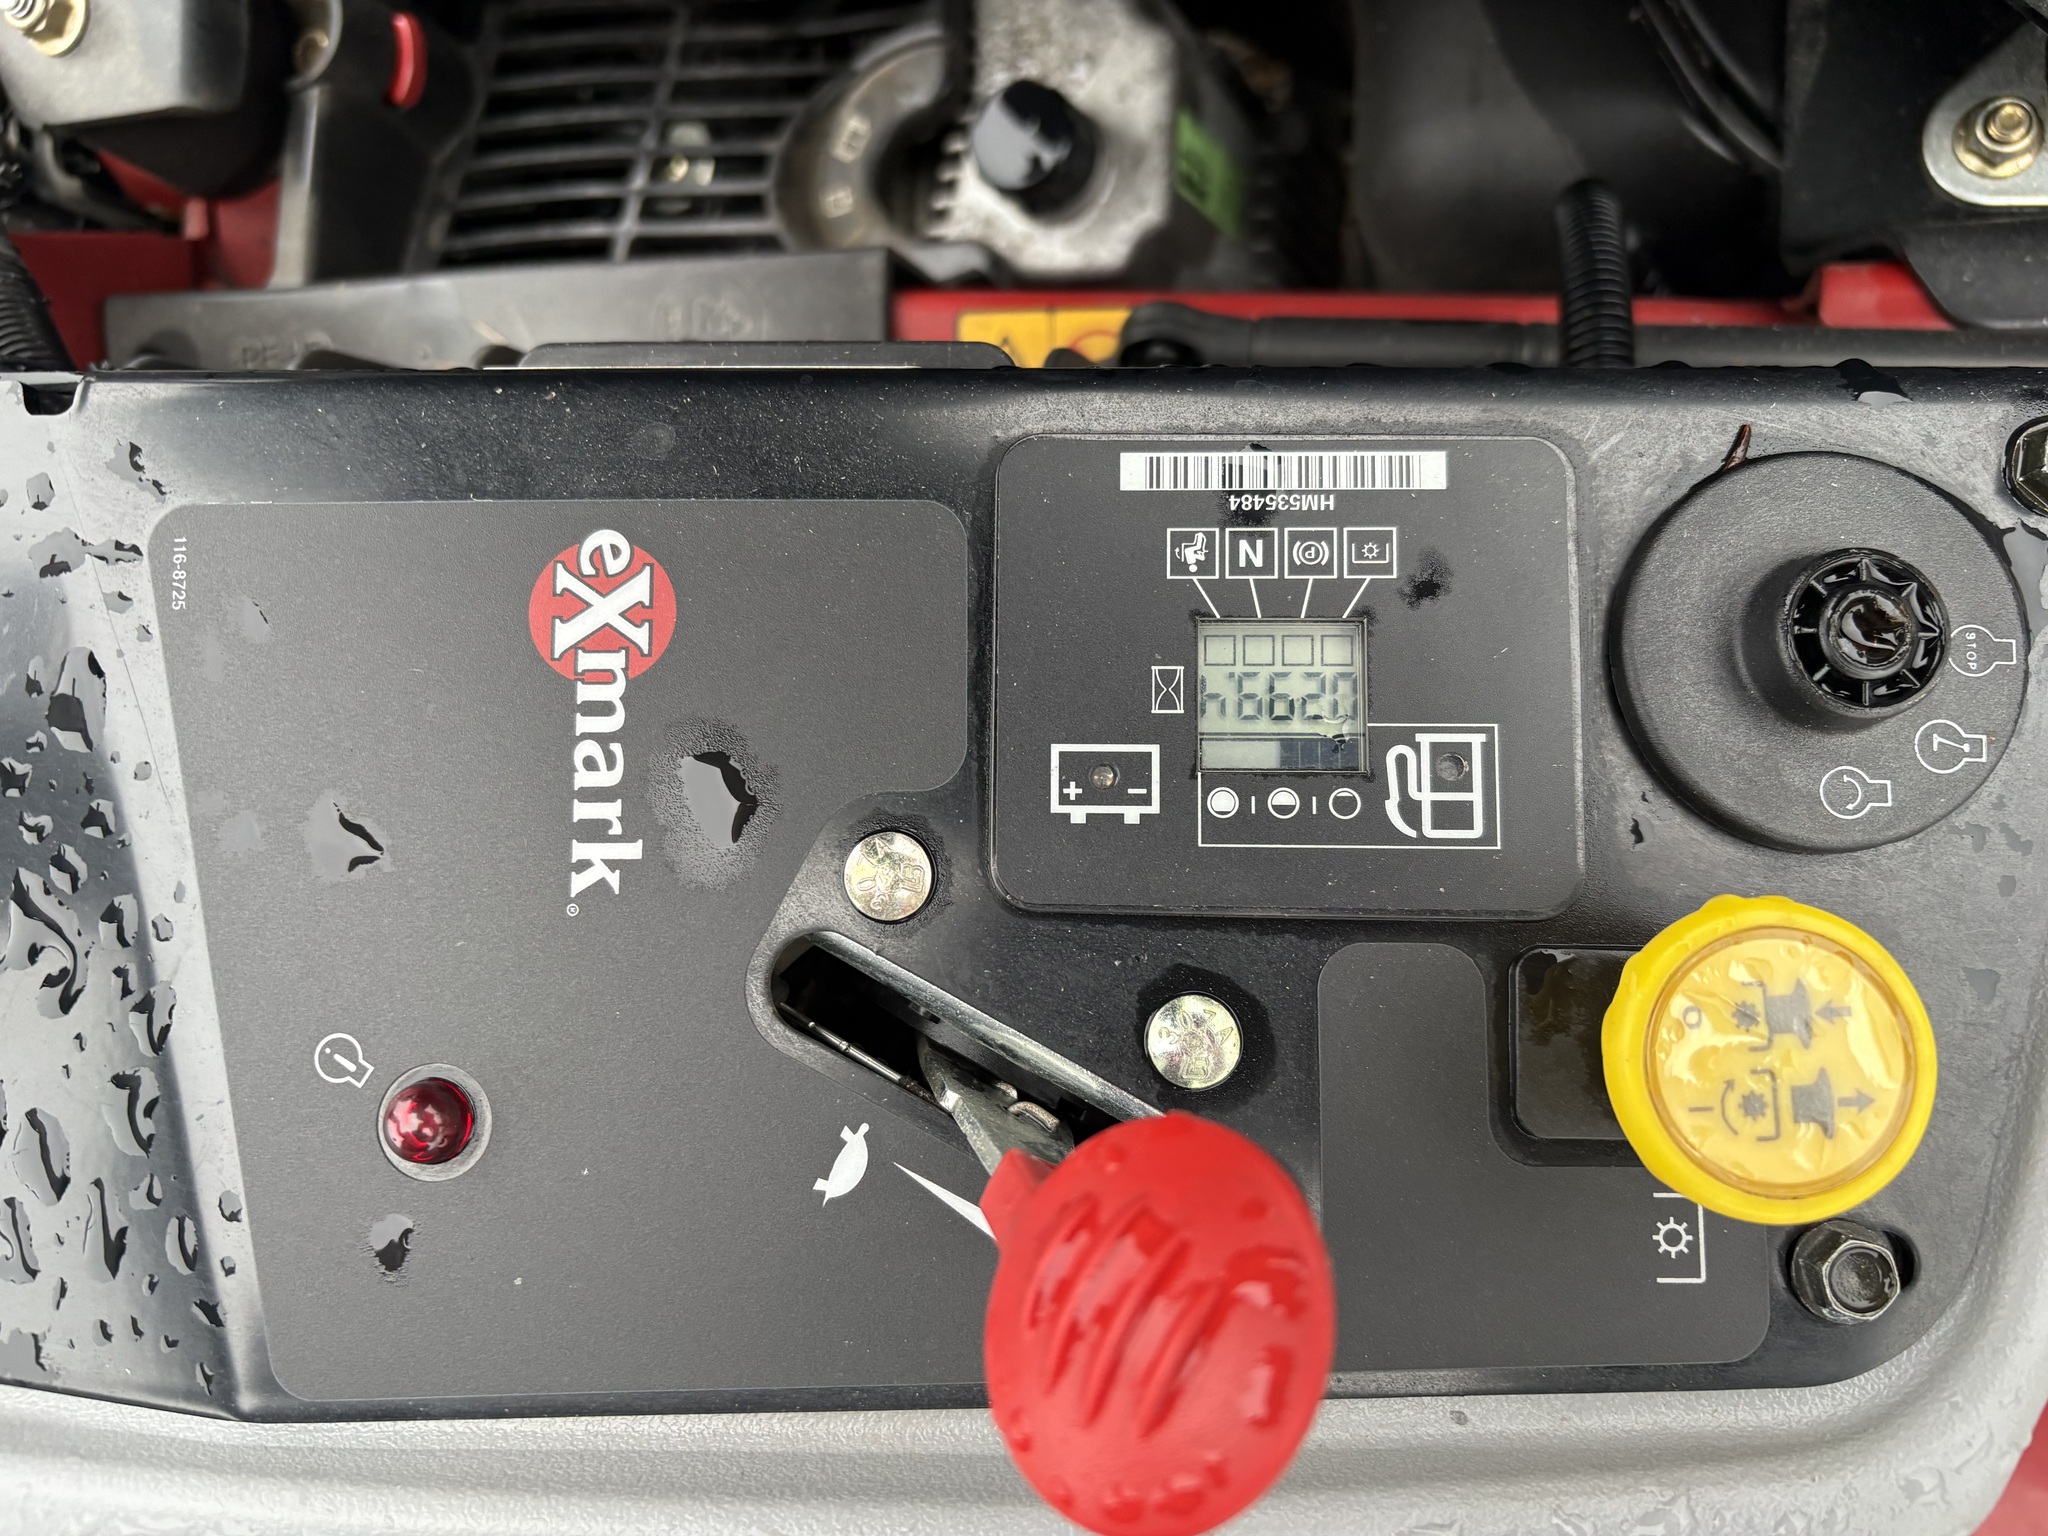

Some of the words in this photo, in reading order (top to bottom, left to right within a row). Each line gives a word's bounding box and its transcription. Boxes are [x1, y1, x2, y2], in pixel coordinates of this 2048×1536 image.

[1228, 494, 1335, 511] HM535484
[172, 536, 187, 610] 116-8725
[1965, 632, 1977, 670] STOP
